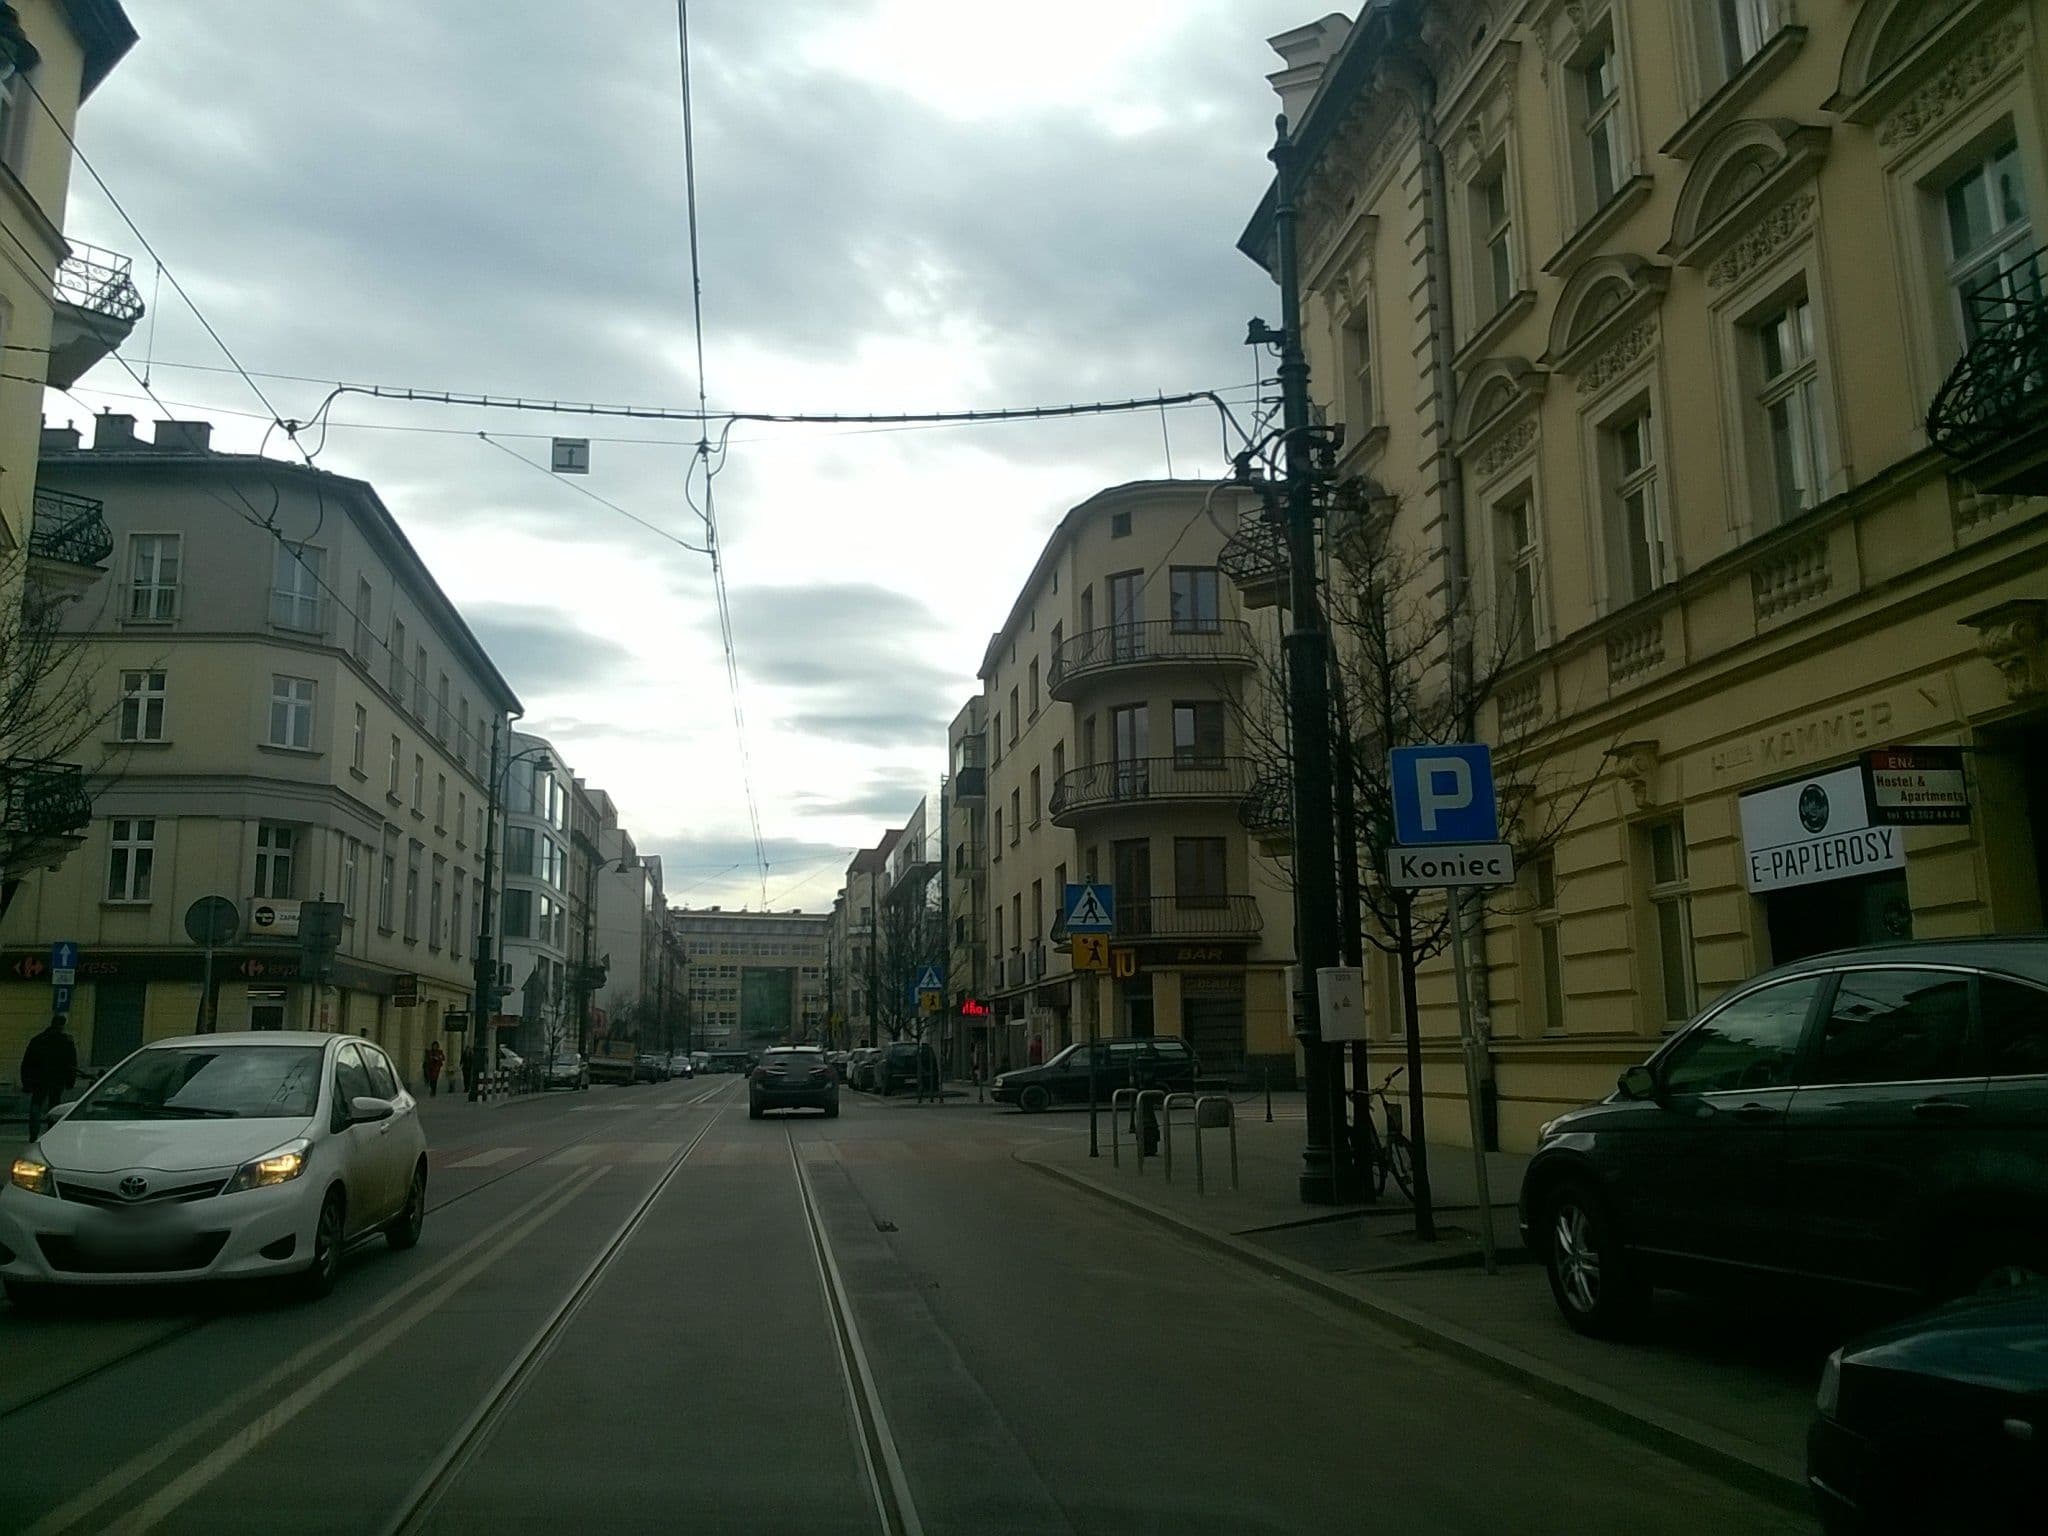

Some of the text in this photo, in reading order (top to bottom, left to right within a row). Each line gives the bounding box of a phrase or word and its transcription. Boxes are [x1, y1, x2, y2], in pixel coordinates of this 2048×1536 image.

[1876, 775, 1926, 788] Hostel &
[1415, 756, 1473, 832] P
[1900, 790, 1964, 804] Apartments
[1751, 828, 1894, 883] E-PAPIEROSY
[1400, 853, 1502, 878] Koniec
[1176, 947, 1224, 961] BAR
